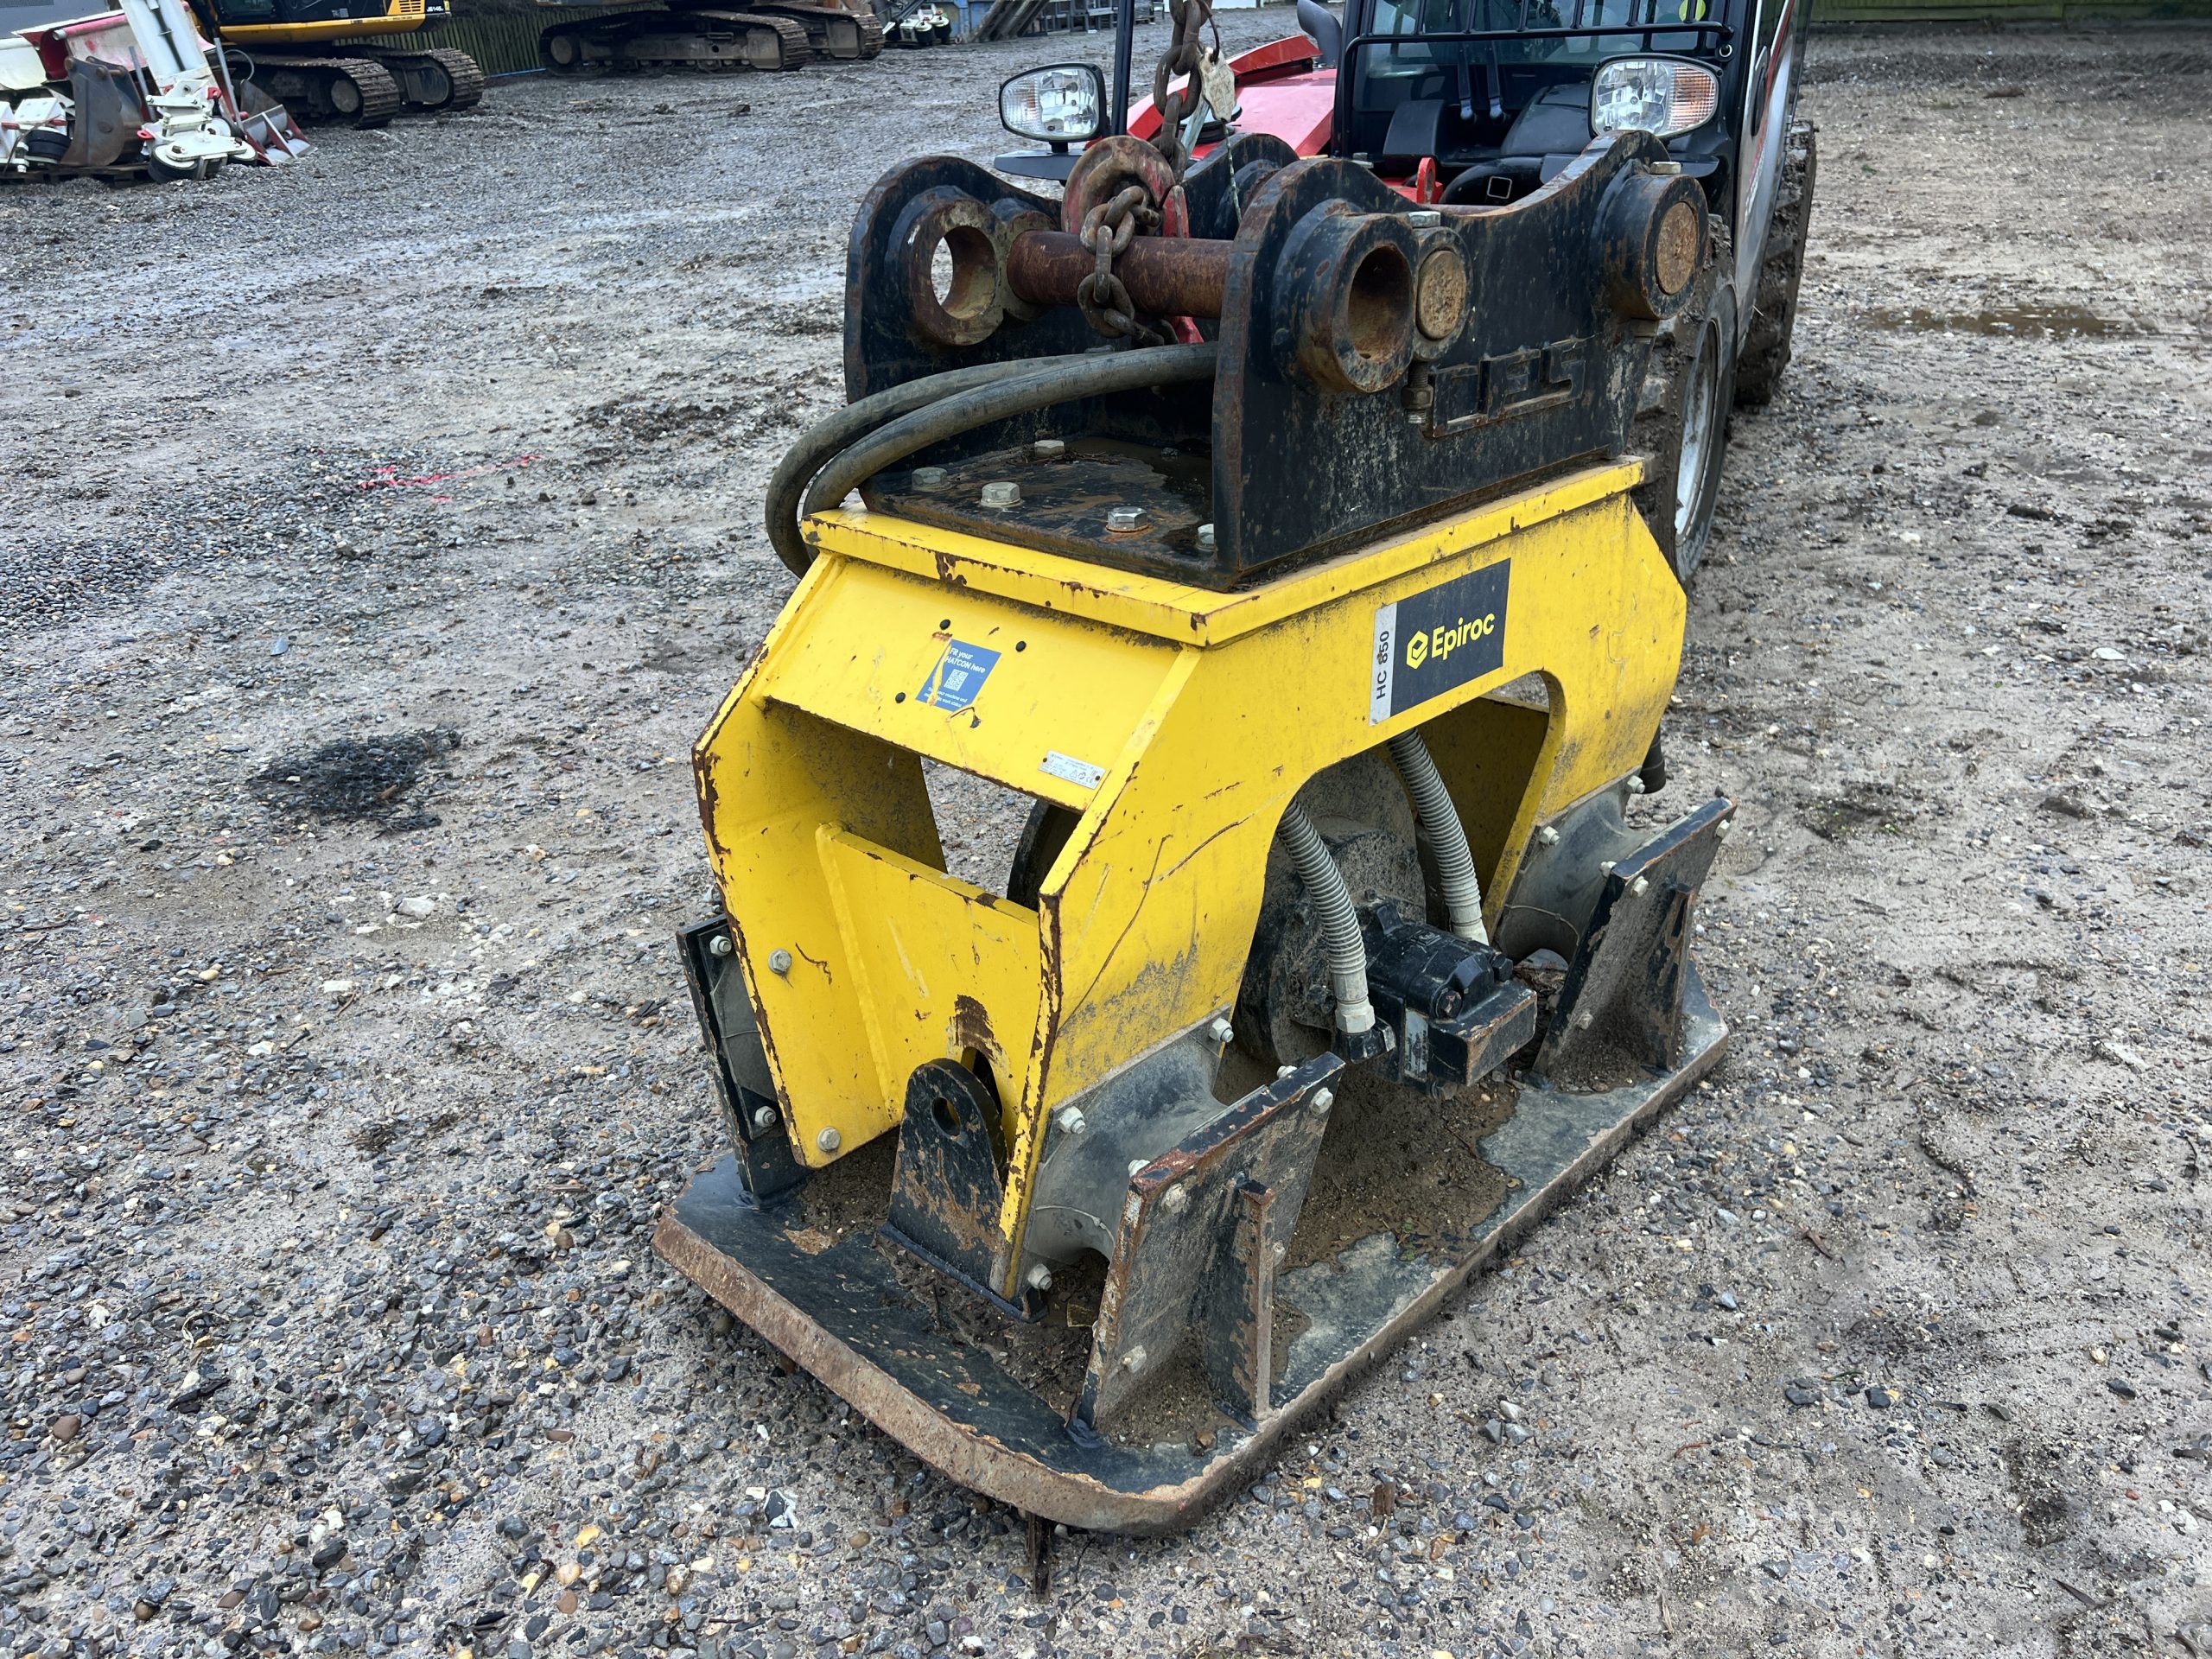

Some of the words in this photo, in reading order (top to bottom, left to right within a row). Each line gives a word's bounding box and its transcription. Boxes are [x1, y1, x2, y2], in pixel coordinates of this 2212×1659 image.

[950, 647, 959, 656] Fit
[1378, 630, 1389, 664] 850
[1432, 613, 1495, 660] Epiroc
[945, 657, 972, 670] HATCON
[970, 664, 986, 674] here
[1376, 670, 1388, 700] HC
